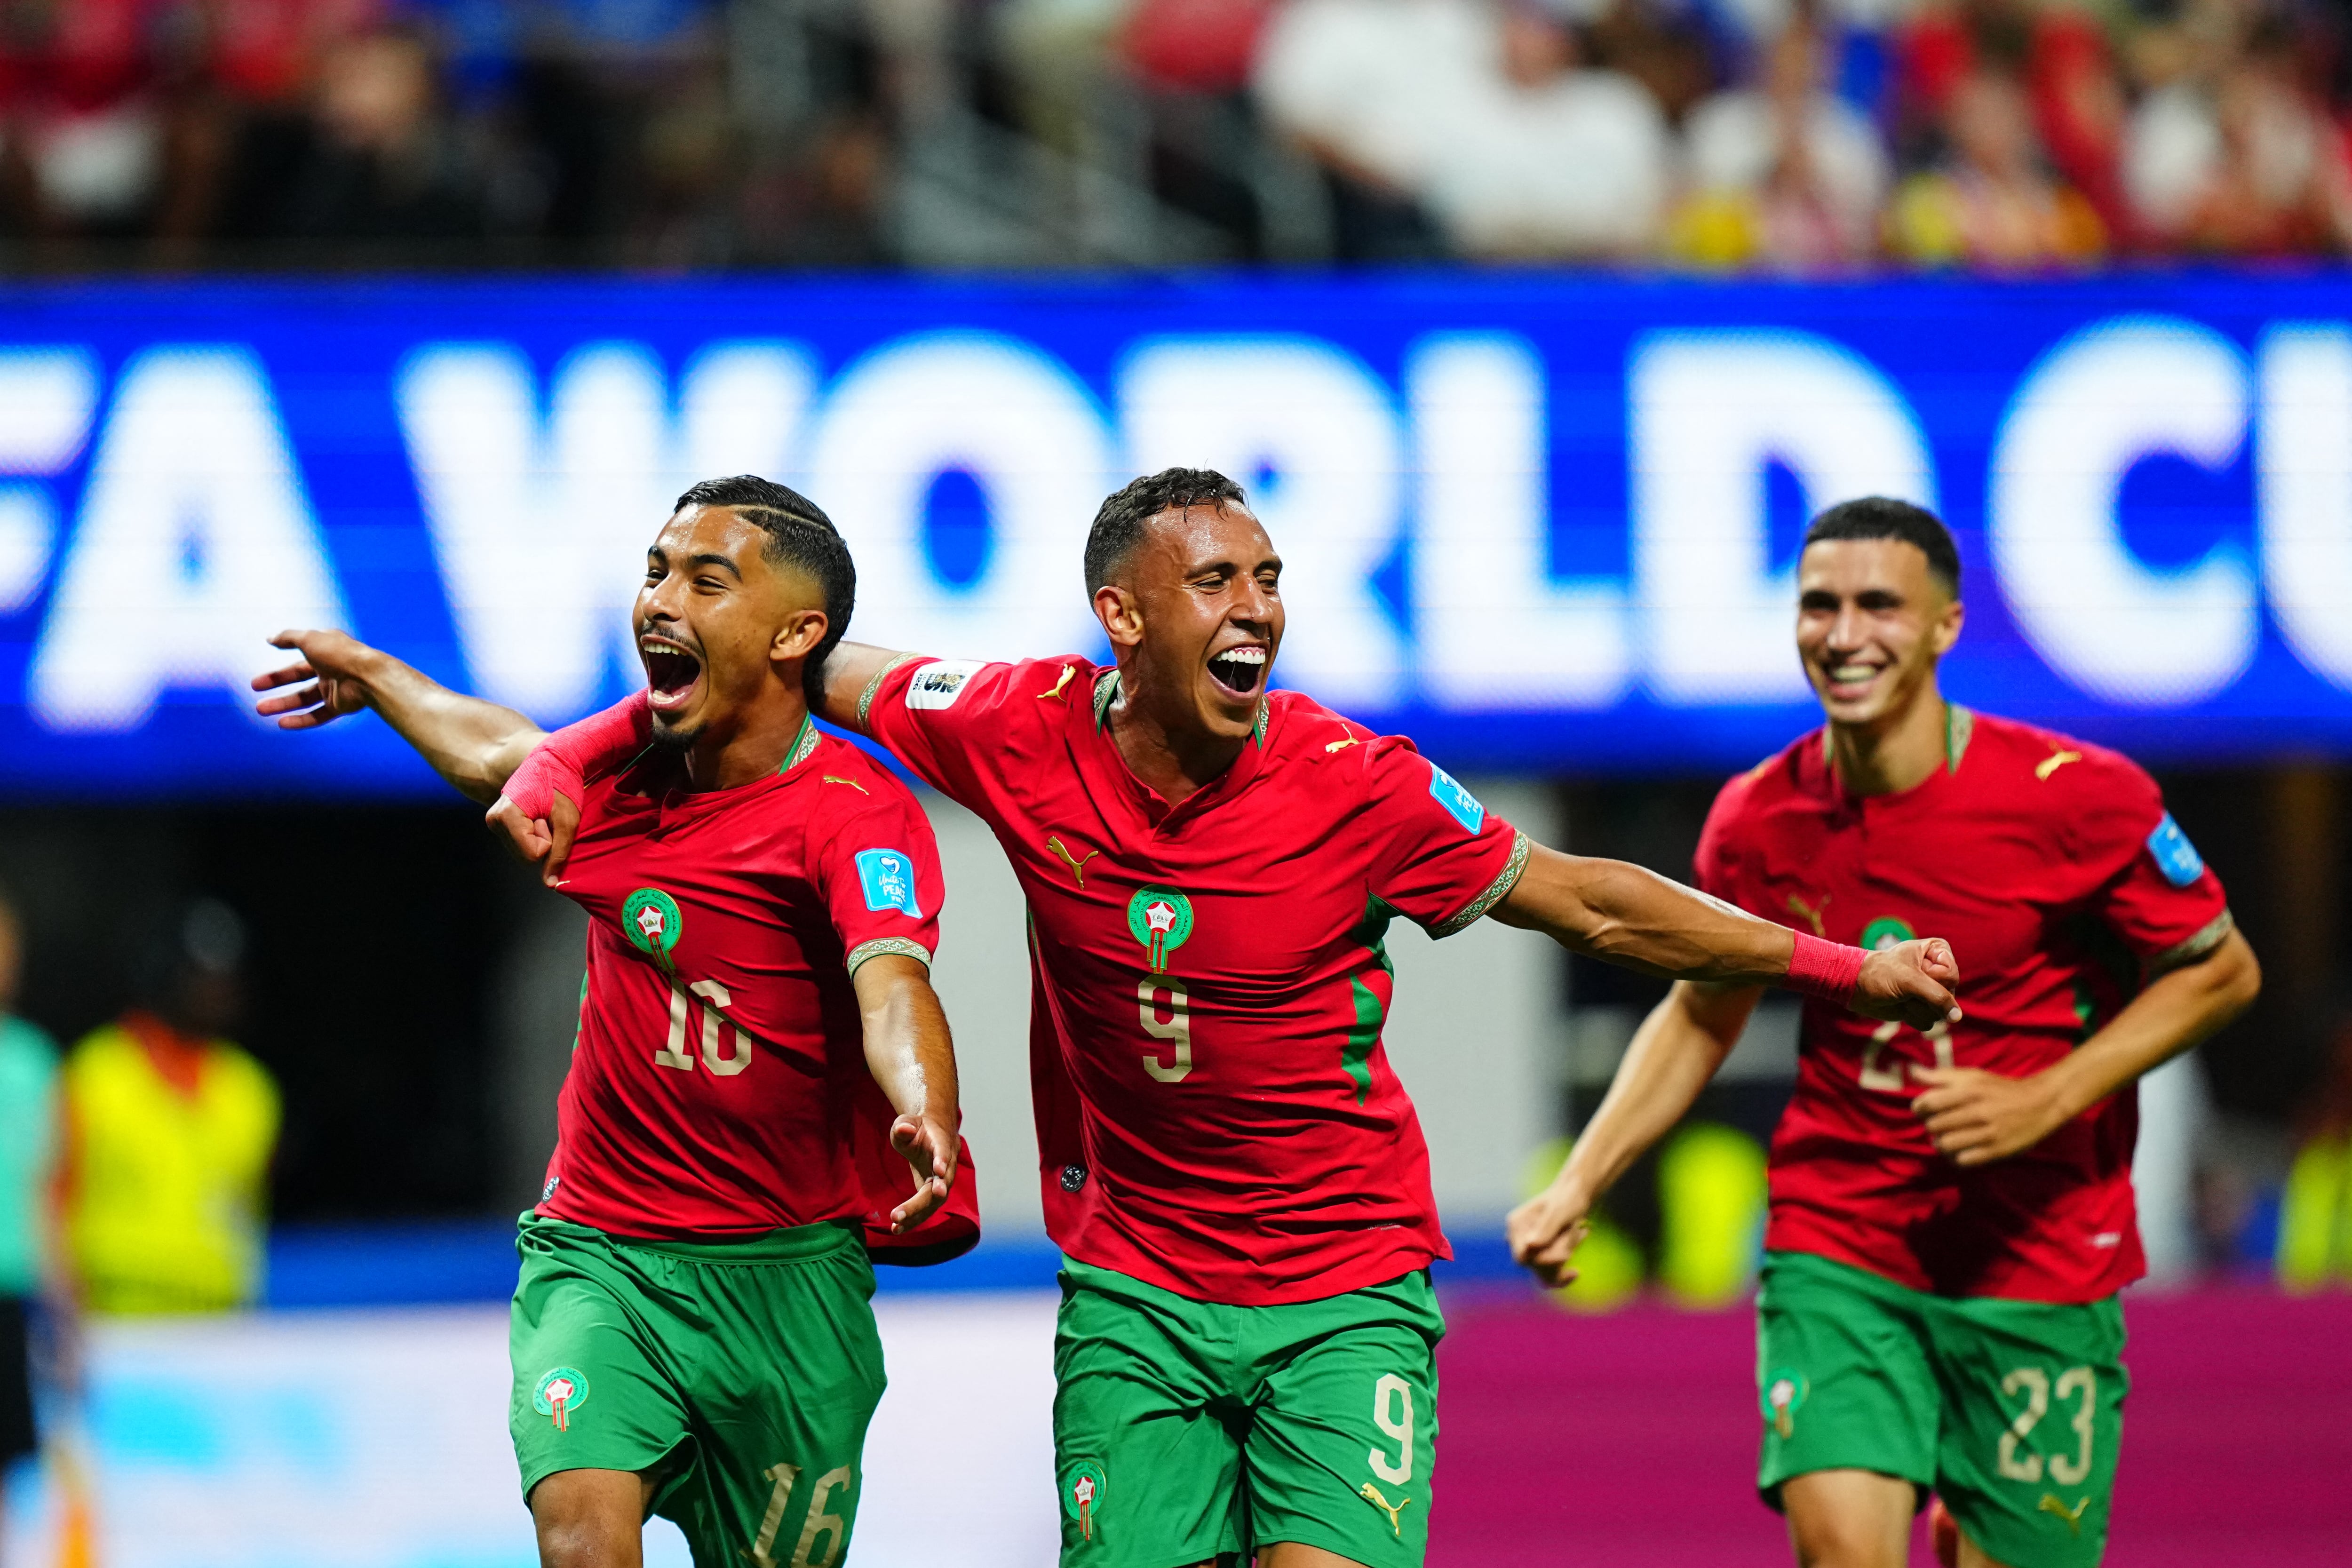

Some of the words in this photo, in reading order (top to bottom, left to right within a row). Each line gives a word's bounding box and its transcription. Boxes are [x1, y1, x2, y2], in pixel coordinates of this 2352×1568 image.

[396, 328, 1938, 732] WORLD
[1143, 897, 1157, 907] ROYALE
[1157, 896, 1178, 910] MAROCAINE
[1169, 918, 1181, 935] FOOTBALL
[655, 975, 752, 1076] 16
[1137, 974, 1192, 1082] 9
[1368, 1373, 1414, 1486] 9
[1998, 1366, 2097, 1486] 23
[739, 1463, 851, 1568] 16
